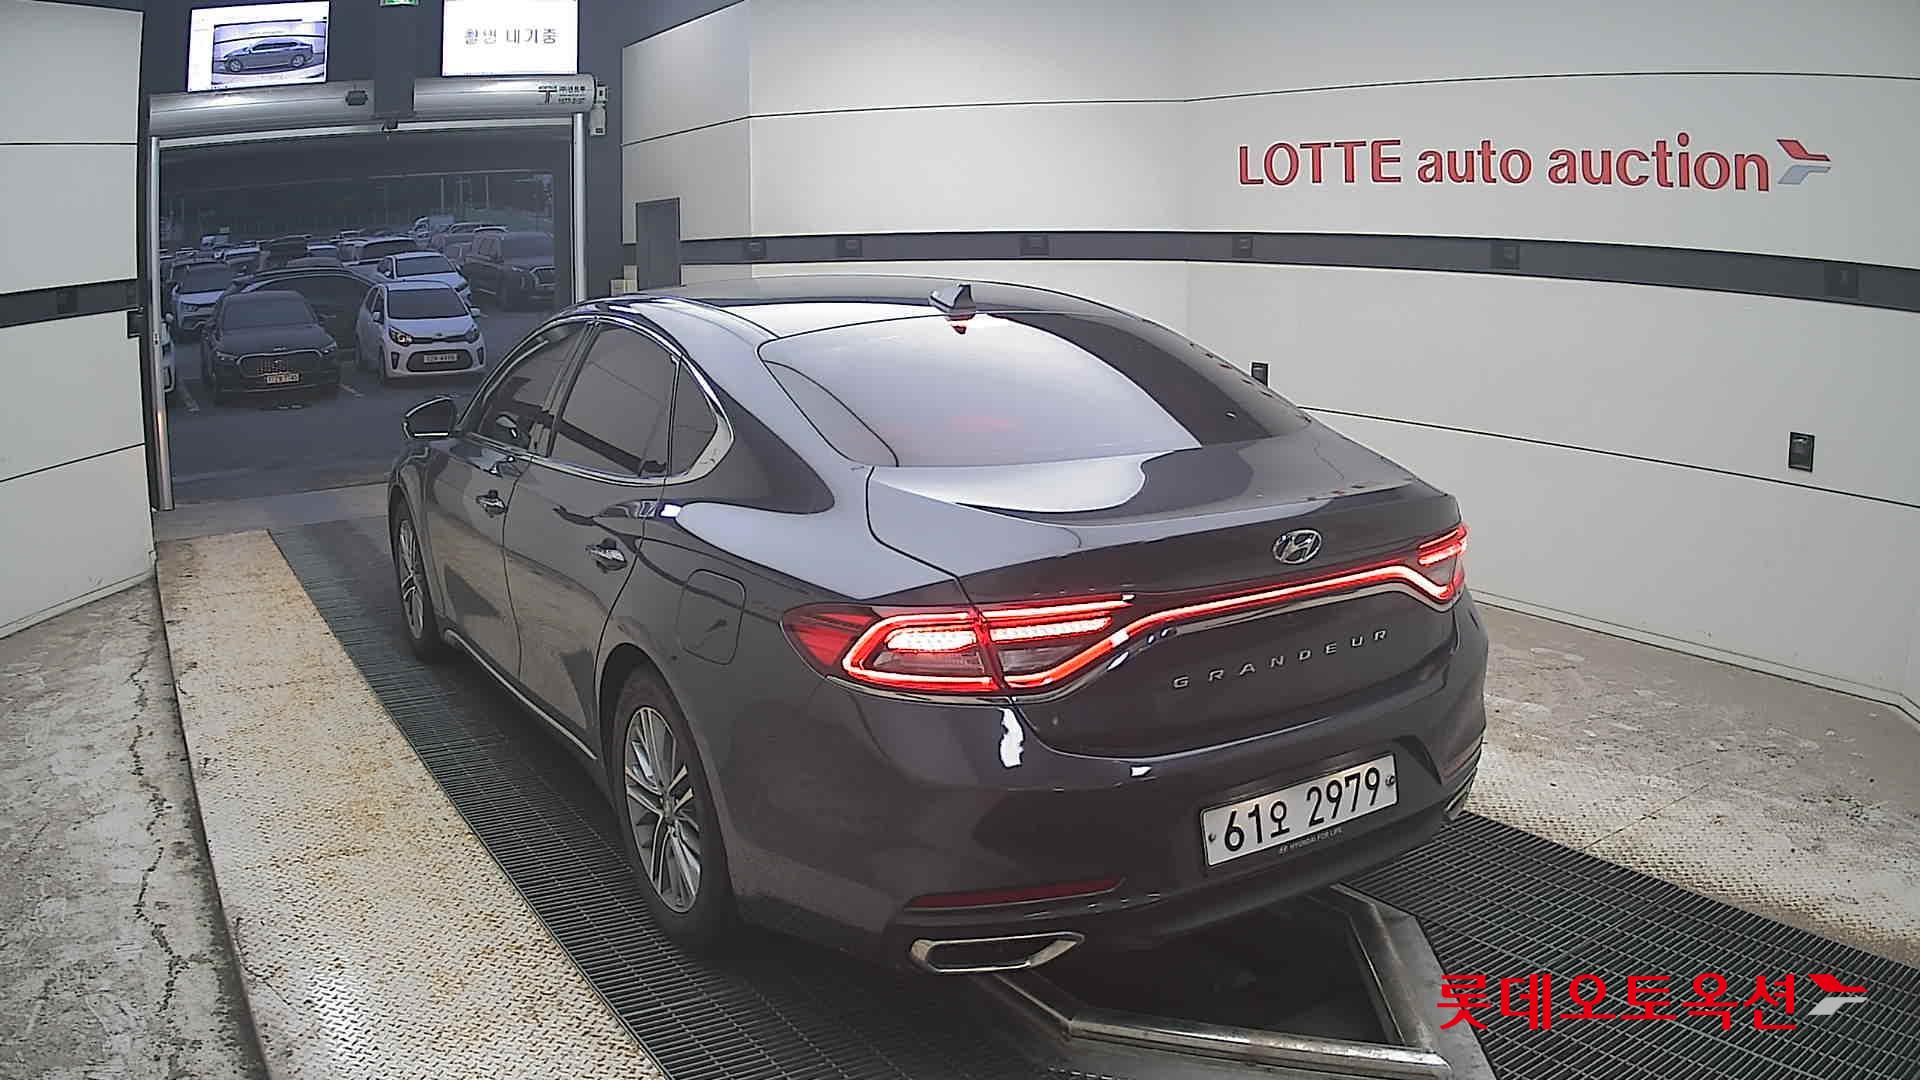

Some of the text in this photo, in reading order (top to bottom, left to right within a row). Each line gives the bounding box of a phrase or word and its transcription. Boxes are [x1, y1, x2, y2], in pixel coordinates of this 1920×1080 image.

[1238, 132, 1770, 192] LOTTE auto auction
[1173, 629, 1387, 689] GRANDEUR
[1224, 766, 1381, 851] 61오 2979
